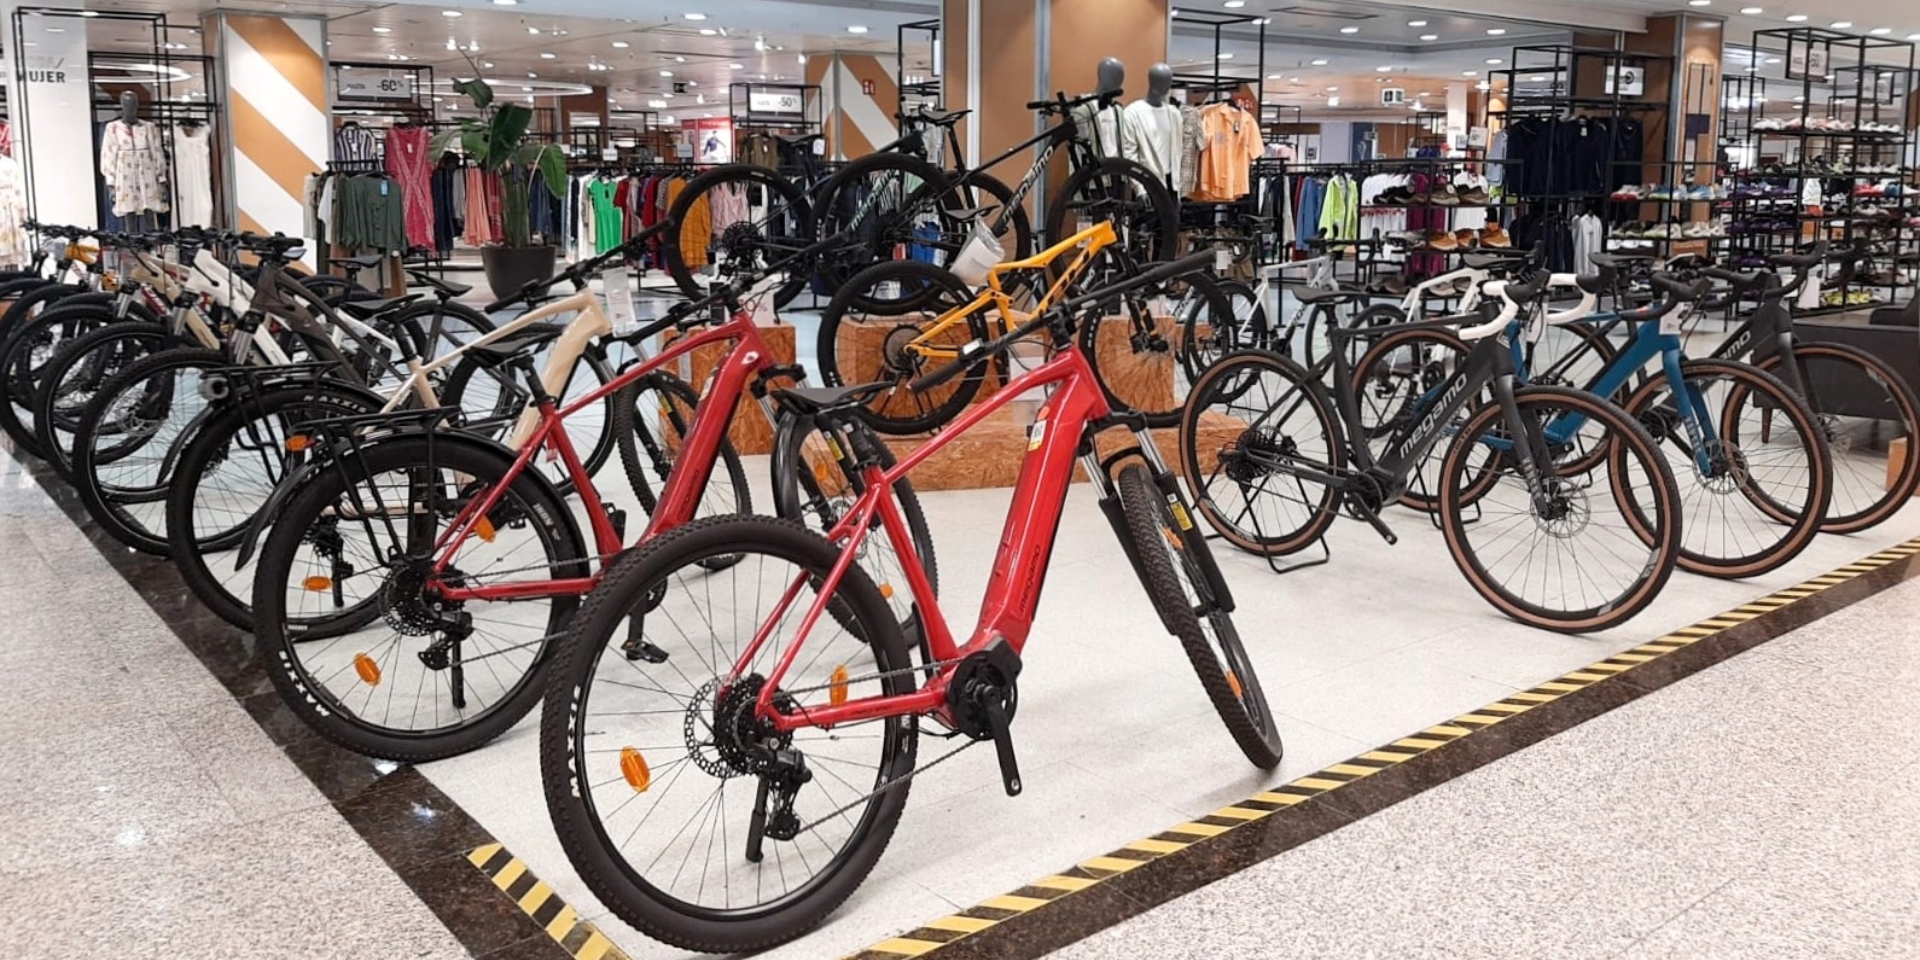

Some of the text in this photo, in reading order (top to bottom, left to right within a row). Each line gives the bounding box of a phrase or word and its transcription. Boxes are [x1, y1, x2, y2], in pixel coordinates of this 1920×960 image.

[1002, 145, 1055, 226] megamo
[1399, 373, 1467, 459] megamo
[1019, 543, 1042, 614] megamo
[279, 650, 331, 717] MAXXIS
[567, 684, 581, 798] MAXXIS
